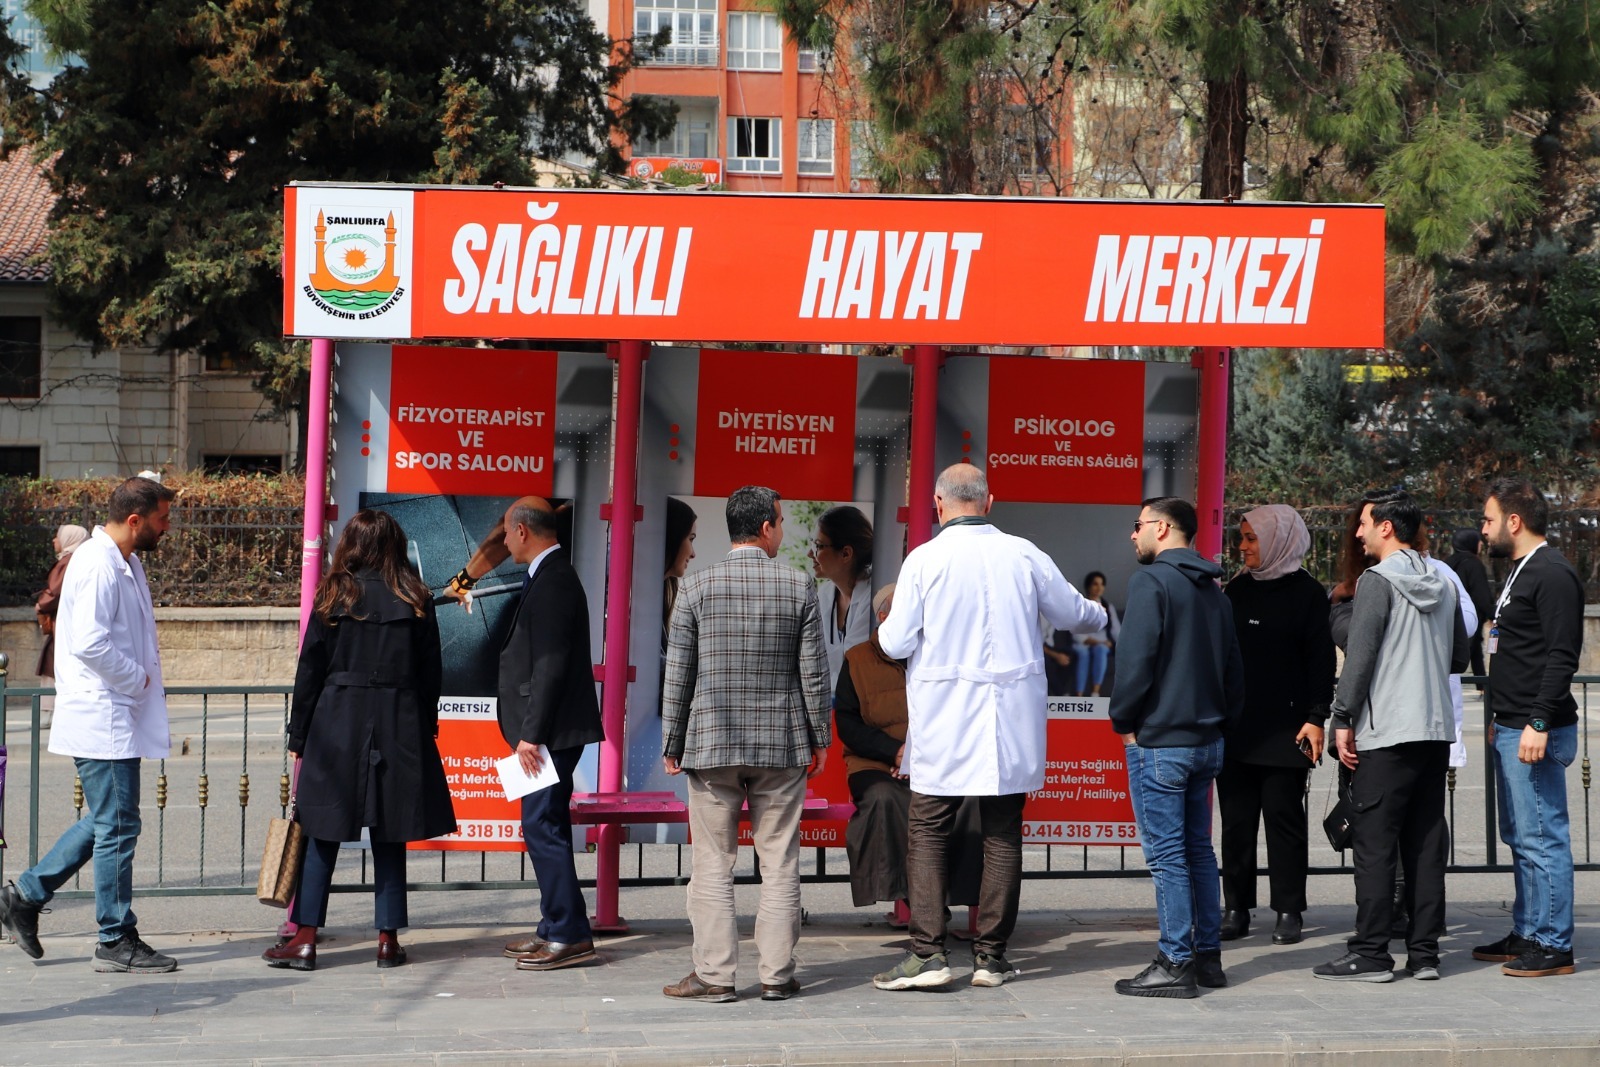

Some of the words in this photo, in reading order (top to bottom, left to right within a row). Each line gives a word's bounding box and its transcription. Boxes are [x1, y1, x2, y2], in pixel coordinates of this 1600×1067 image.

[326, 216, 386, 226] ŞANLIURFA
[442, 201, 694, 316] SAĞLIKLI
[798, 229, 983, 320] HAYAT
[1084, 218, 1326, 325] MERKEZİ
[303, 285, 356, 320] BÜYÜKŞEHİR
[358, 286, 406, 320] BELEDİYESİ
[397, 402, 546, 427] FİZYOTERAPİST
[718, 407, 835, 433] DİYETİSYEN
[1013, 414, 1116, 437] PSİKOLOG
[457, 430, 484, 448] VE
[735, 431, 817, 455] HİZMETİ
[1054, 440, 1071, 452] VE
[394, 451, 452, 470] SPOR
[457, 453, 544, 473] SALONU
[988, 453, 1039, 468] ÇOCUK
[1041, 455, 1084, 468] ERGEN
[1086, 453, 1139, 469] SAĞLIĞI
[1046, 700, 1094, 713] CRETSİZ
[463, 756, 502, 771] Sağlı
[1044, 761, 1079, 772] asuyu
[1080, 759, 1123, 773] Sağlıklı
[462, 774, 502, 785] Merke
[1060, 774, 1106, 785] Merkezi
[486, 789, 506, 798] Has
[1027, 789, 1074, 801] yasuyu
[1083, 788, 1126, 802] Haliliye
[467, 824, 493, 838] 318
[497, 824, 514, 838] 19
[799, 828, 837, 841] RLÜĞÜ
[1021, 824, 1063, 838] 0.414
[1066, 824, 1092, 838] 318
[1095, 824, 1114, 838] 75
[1117, 824, 1137, 839] 53
